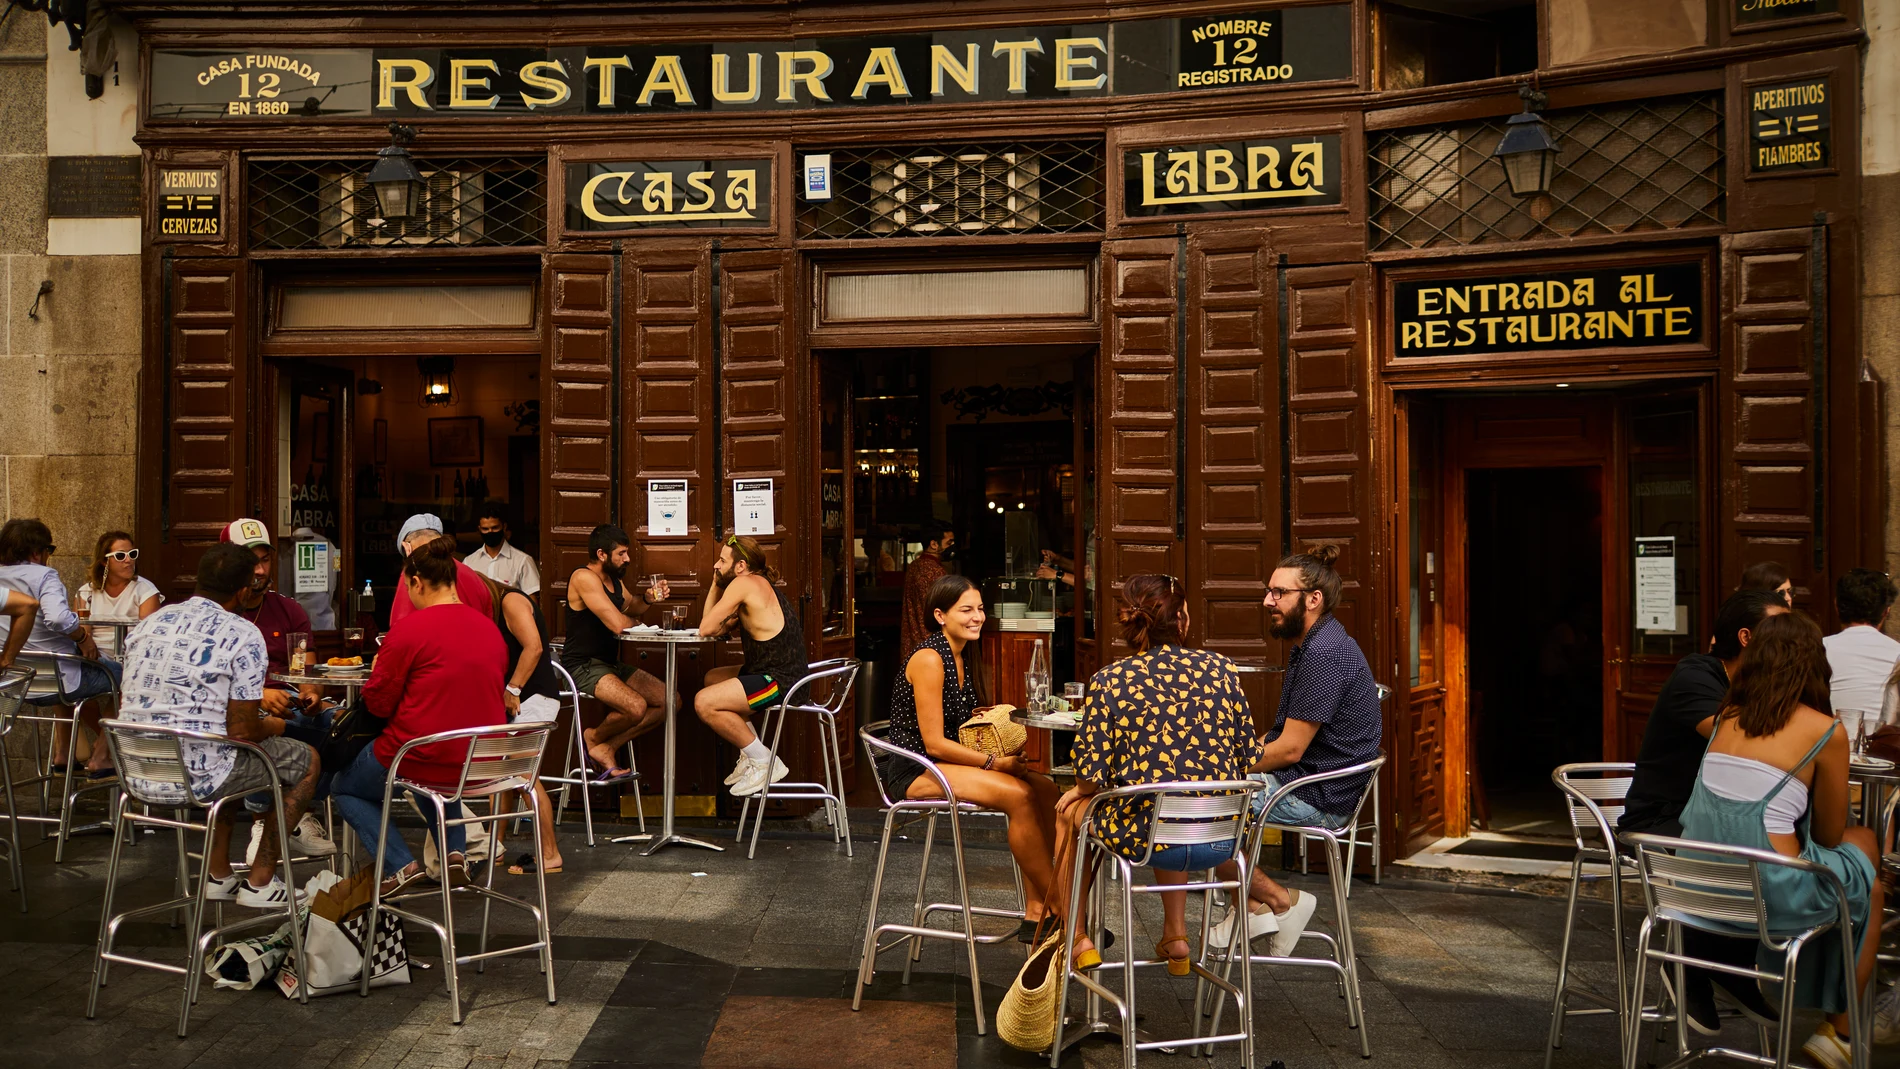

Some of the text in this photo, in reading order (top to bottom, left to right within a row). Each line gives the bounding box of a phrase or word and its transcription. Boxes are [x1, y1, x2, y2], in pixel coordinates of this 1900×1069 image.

[1192, 20, 1272, 43] NOMBRE
[1213, 37, 1258, 66] 12
[197, 55, 320, 86] CASA FUNDADA
[376, 37, 1108, 111] RESTAURANTE
[1178, 64, 1293, 87] REGISTRADO
[238, 73, 280, 98] 12
[228, 101, 289, 115] EN 1860
[1753, 84, 1825, 111] APERITIVOS
[1785, 116, 1793, 135] Y
[1759, 141, 1821, 166] FIAMBRES
[164, 171, 217, 188] VERMUTS
[1139, 142, 1327, 206] LABRA
[186, 195, 194, 210] Y
[581, 169, 757, 222] CASA
[162, 218, 218, 234] CERVEZAS
[1418, 274, 1674, 316] ENTRADA AL
[1402, 307, 1693, 348] RESTAURANTE
[291, 483, 329, 502] CASA
[823, 483, 842, 502] CASA
[822, 510, 844, 528] LABRA
[300, 546, 314, 568] H
